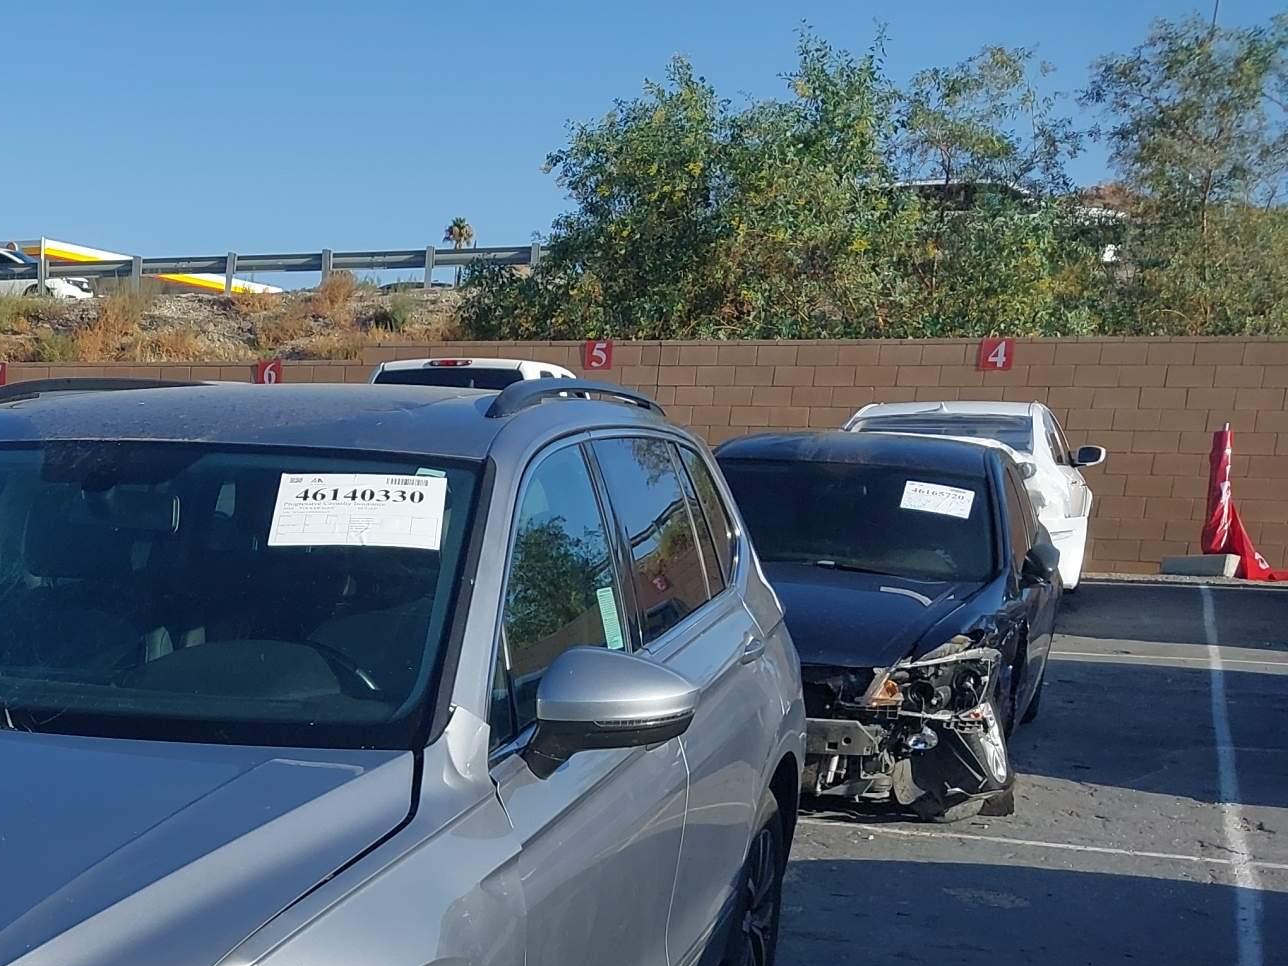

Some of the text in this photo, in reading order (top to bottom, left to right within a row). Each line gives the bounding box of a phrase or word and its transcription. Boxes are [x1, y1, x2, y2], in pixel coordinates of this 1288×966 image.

[591, 343, 607, 367] 5
[987, 341, 1007, 368] 4
[263, 362, 276, 385] 6
[296, 487, 425, 503] 46140330
